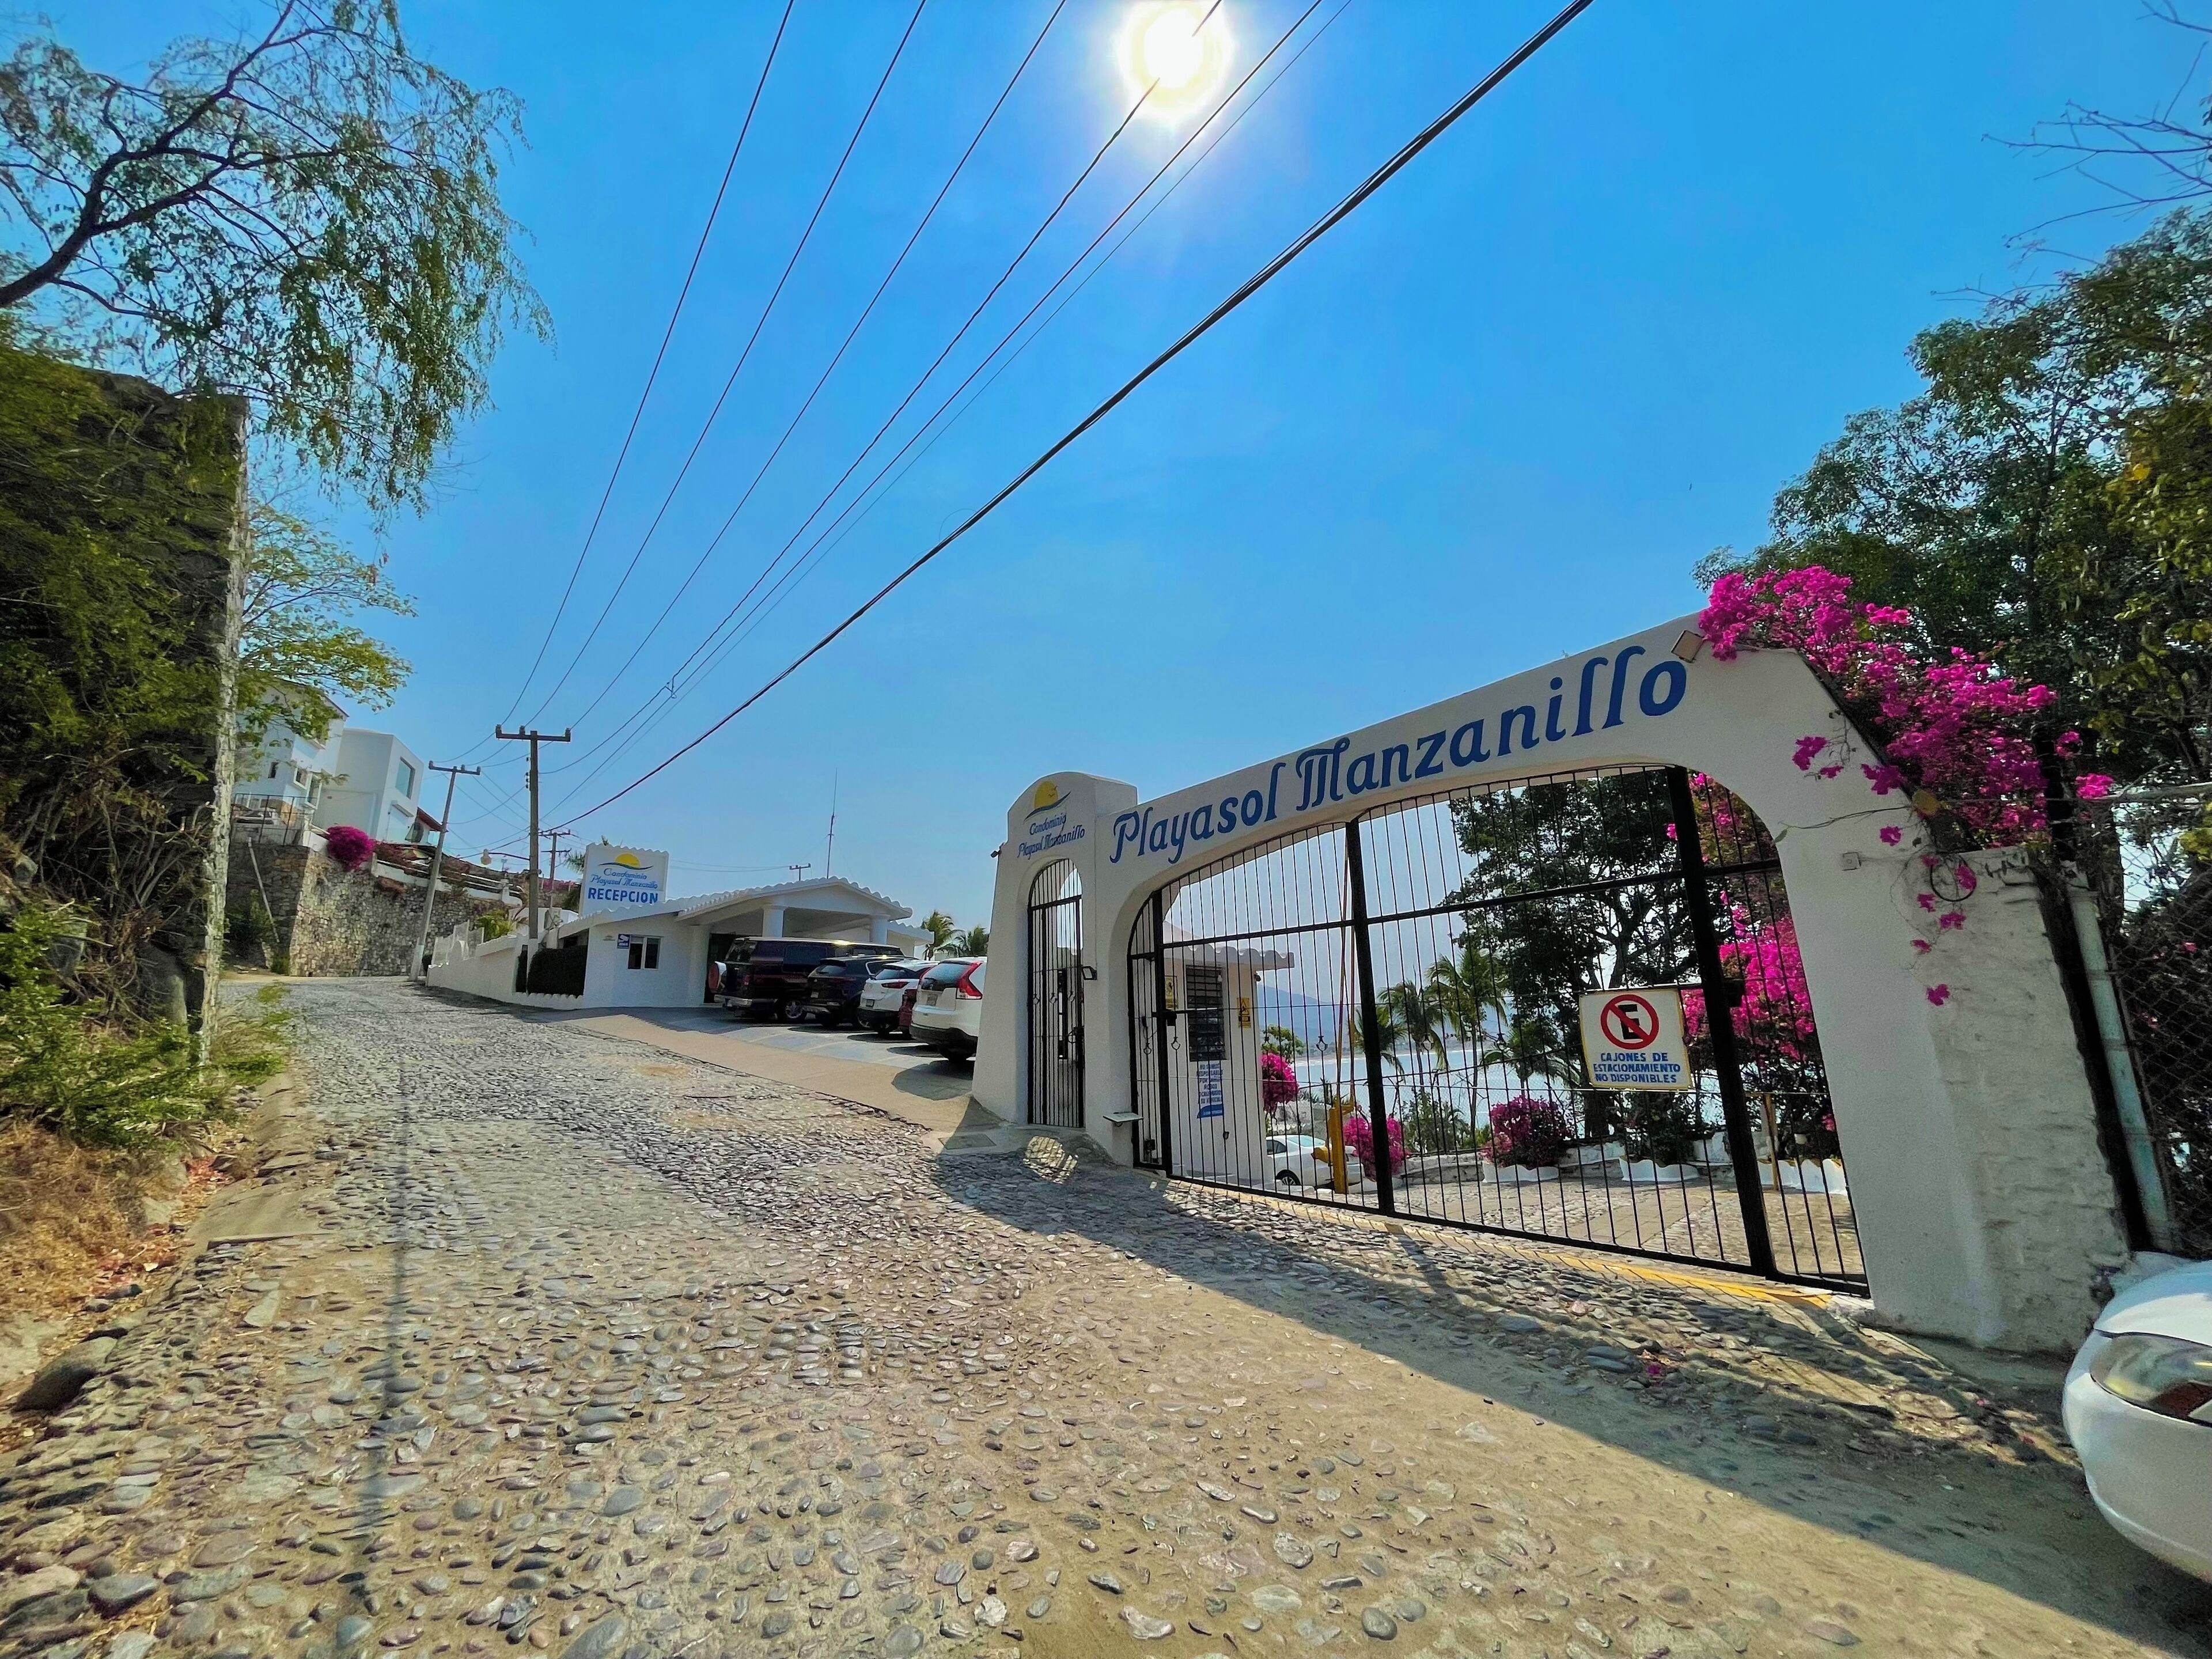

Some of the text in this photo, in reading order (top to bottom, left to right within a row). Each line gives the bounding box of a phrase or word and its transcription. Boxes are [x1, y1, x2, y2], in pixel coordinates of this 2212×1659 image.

[1109, 646, 1687, 864] Playasol Manzanillo
[590, 874, 622, 886] Playasol
[603, 868, 647, 880] Condominio
[588, 888, 658, 904] RECEPCION
[1601, 1052, 1668, 1062] CAJONES DE
[1593, 1064, 1681, 1072] ESTACIONAMIENTO
[1595, 1074, 1677, 1083] NO DISPONIBLES
